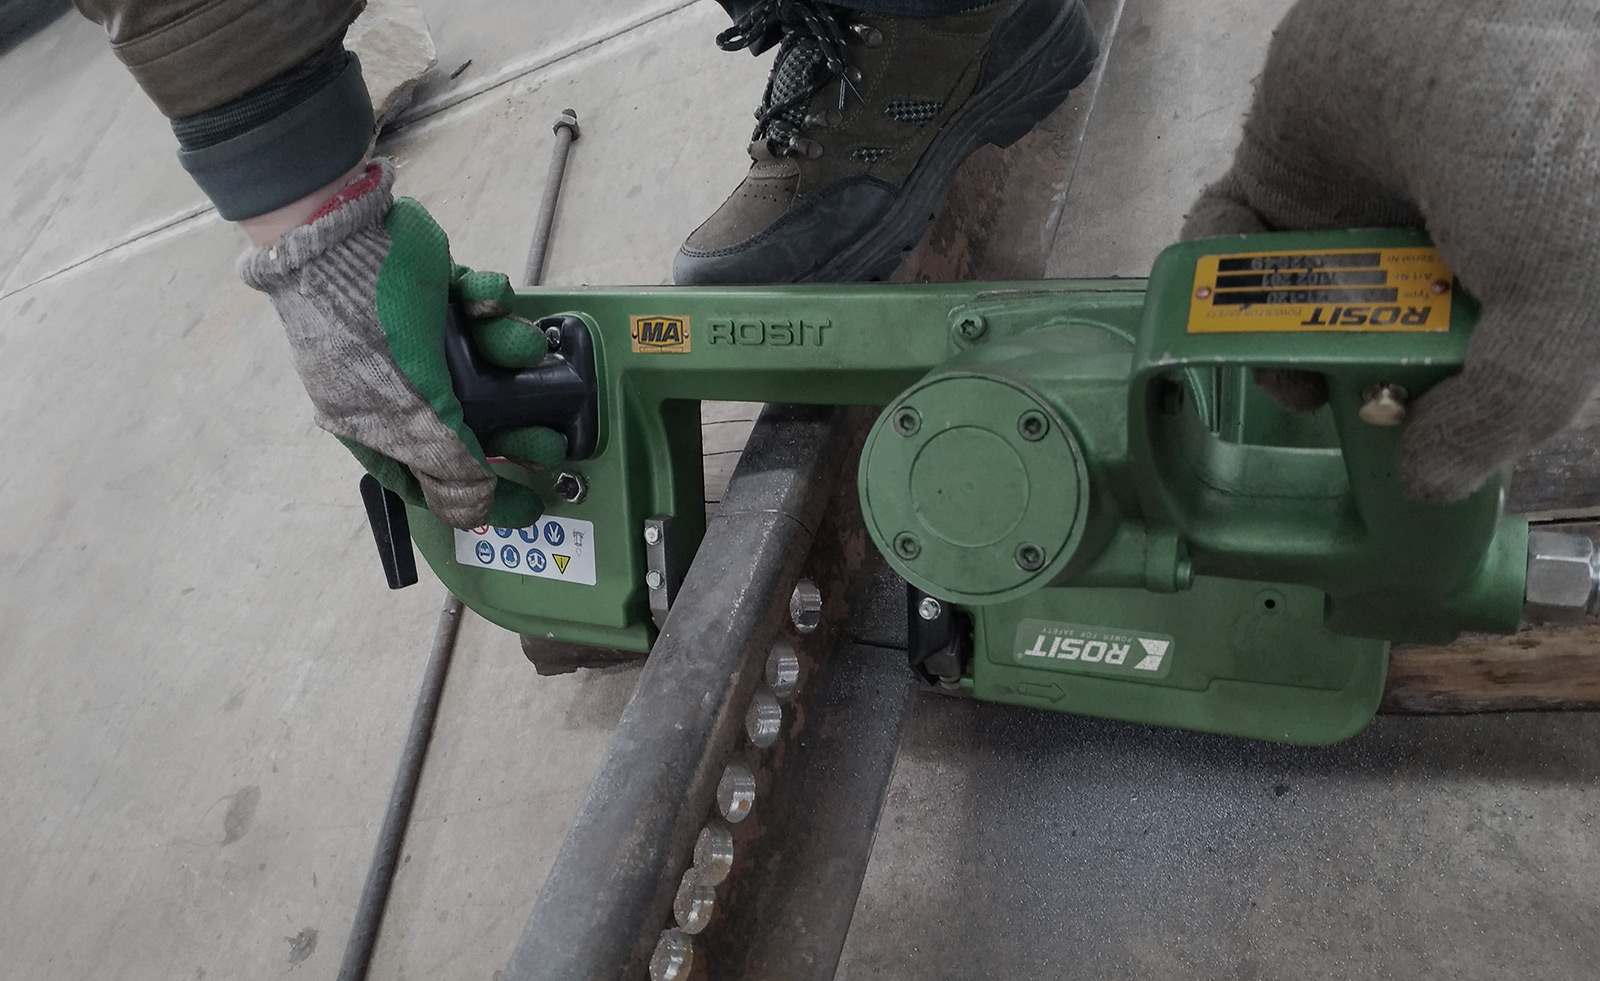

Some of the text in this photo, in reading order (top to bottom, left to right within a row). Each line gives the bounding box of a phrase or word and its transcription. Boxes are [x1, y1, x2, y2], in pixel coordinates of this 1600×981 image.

[1412, 272, 1433, 281] Art
[1402, 289, 1430, 299] Type
[1300, 306, 1432, 326] ROSIT
[641, 321, 681, 342] MA
[706, 317, 832, 347] ROSIT
[1041, 627, 1132, 643] POWER FOR SAFETY
[1024, 635, 1131, 665] ROSIT
